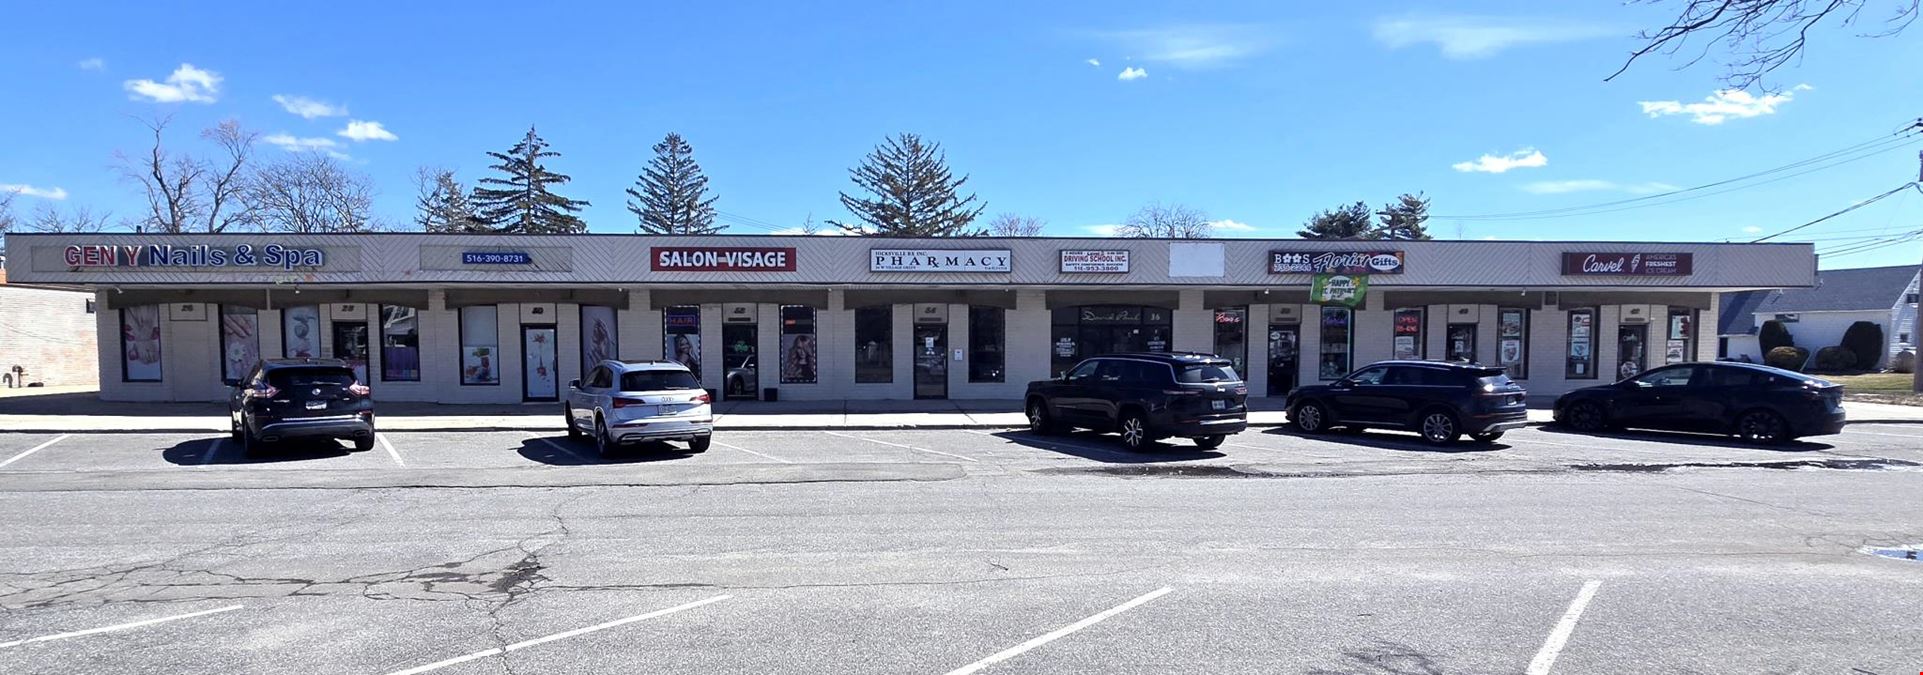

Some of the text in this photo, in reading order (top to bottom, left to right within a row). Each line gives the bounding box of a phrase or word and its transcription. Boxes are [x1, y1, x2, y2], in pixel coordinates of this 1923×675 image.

[64, 244, 323, 271] GEN Y Nails & Spa
[466, 254, 524, 263] 516-390-8731
[660, 251, 786, 267] SALON VISAGE
[876, 256, 1007, 268] PHARMACY
[1312, 251, 1398, 272] Florist Gifts
[1583, 254, 1625, 272] Carvel
